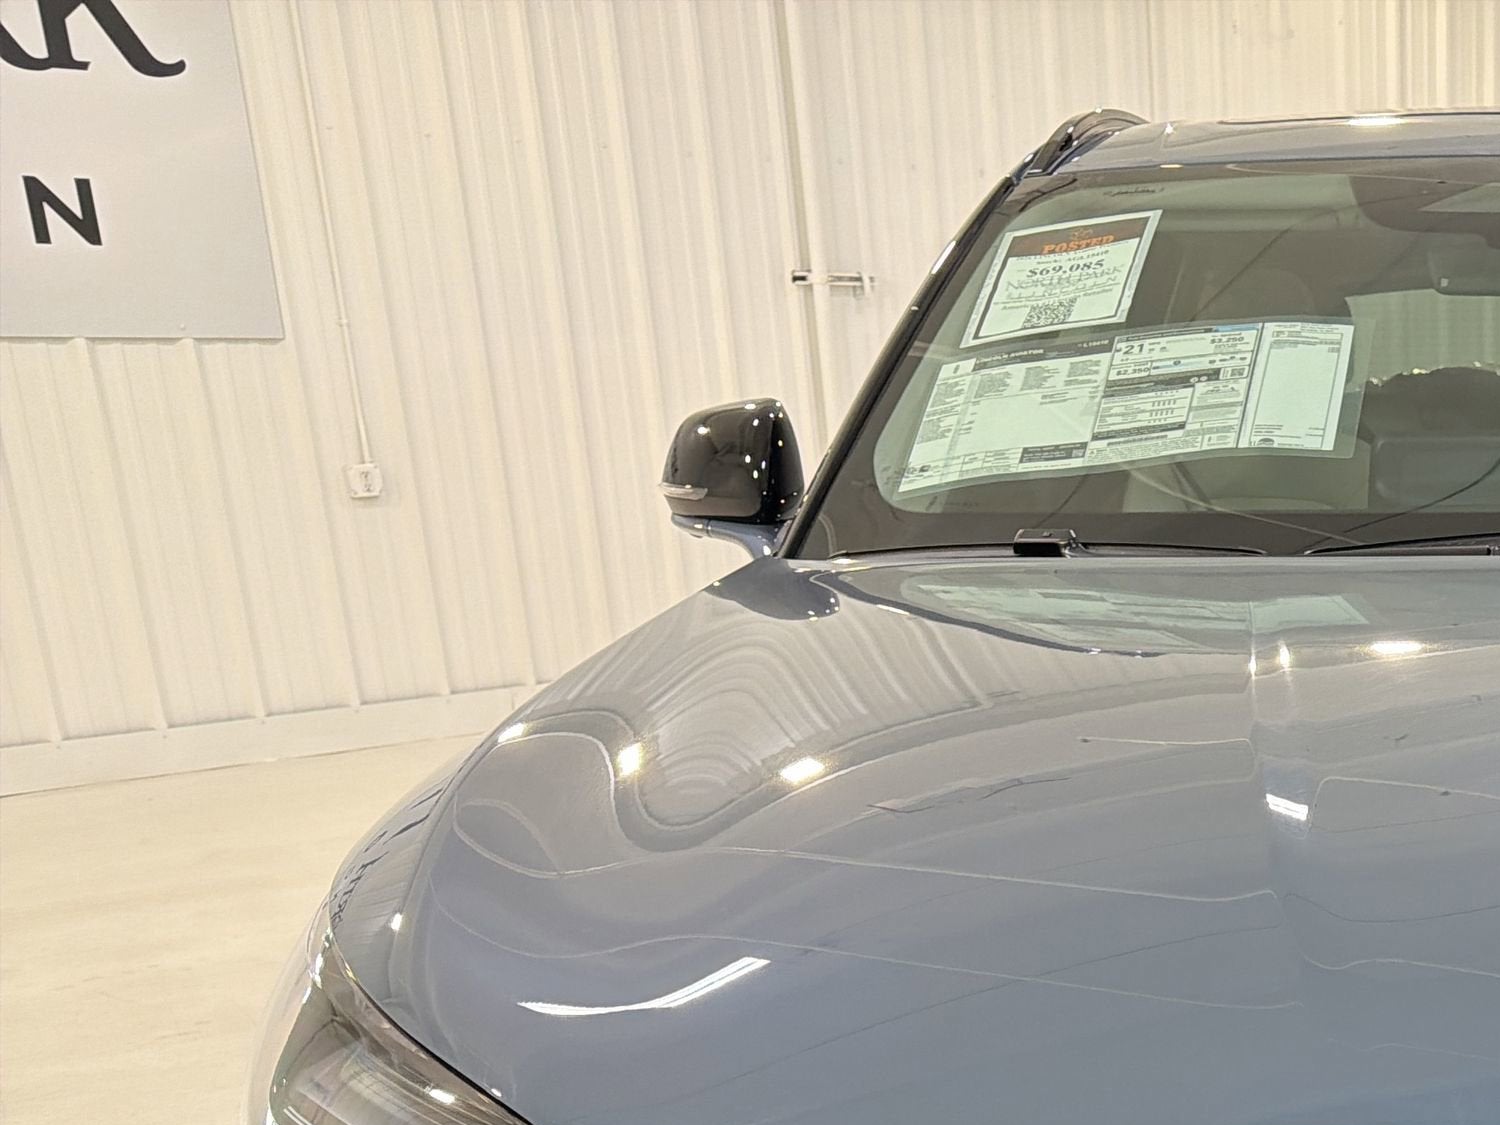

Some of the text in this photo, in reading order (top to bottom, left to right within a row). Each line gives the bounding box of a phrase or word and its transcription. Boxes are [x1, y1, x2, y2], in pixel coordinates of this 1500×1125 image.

[22, 175, 103, 246] N
[1040, 234, 1115, 255] POSTED
[1122, 343, 1145, 355] 21
